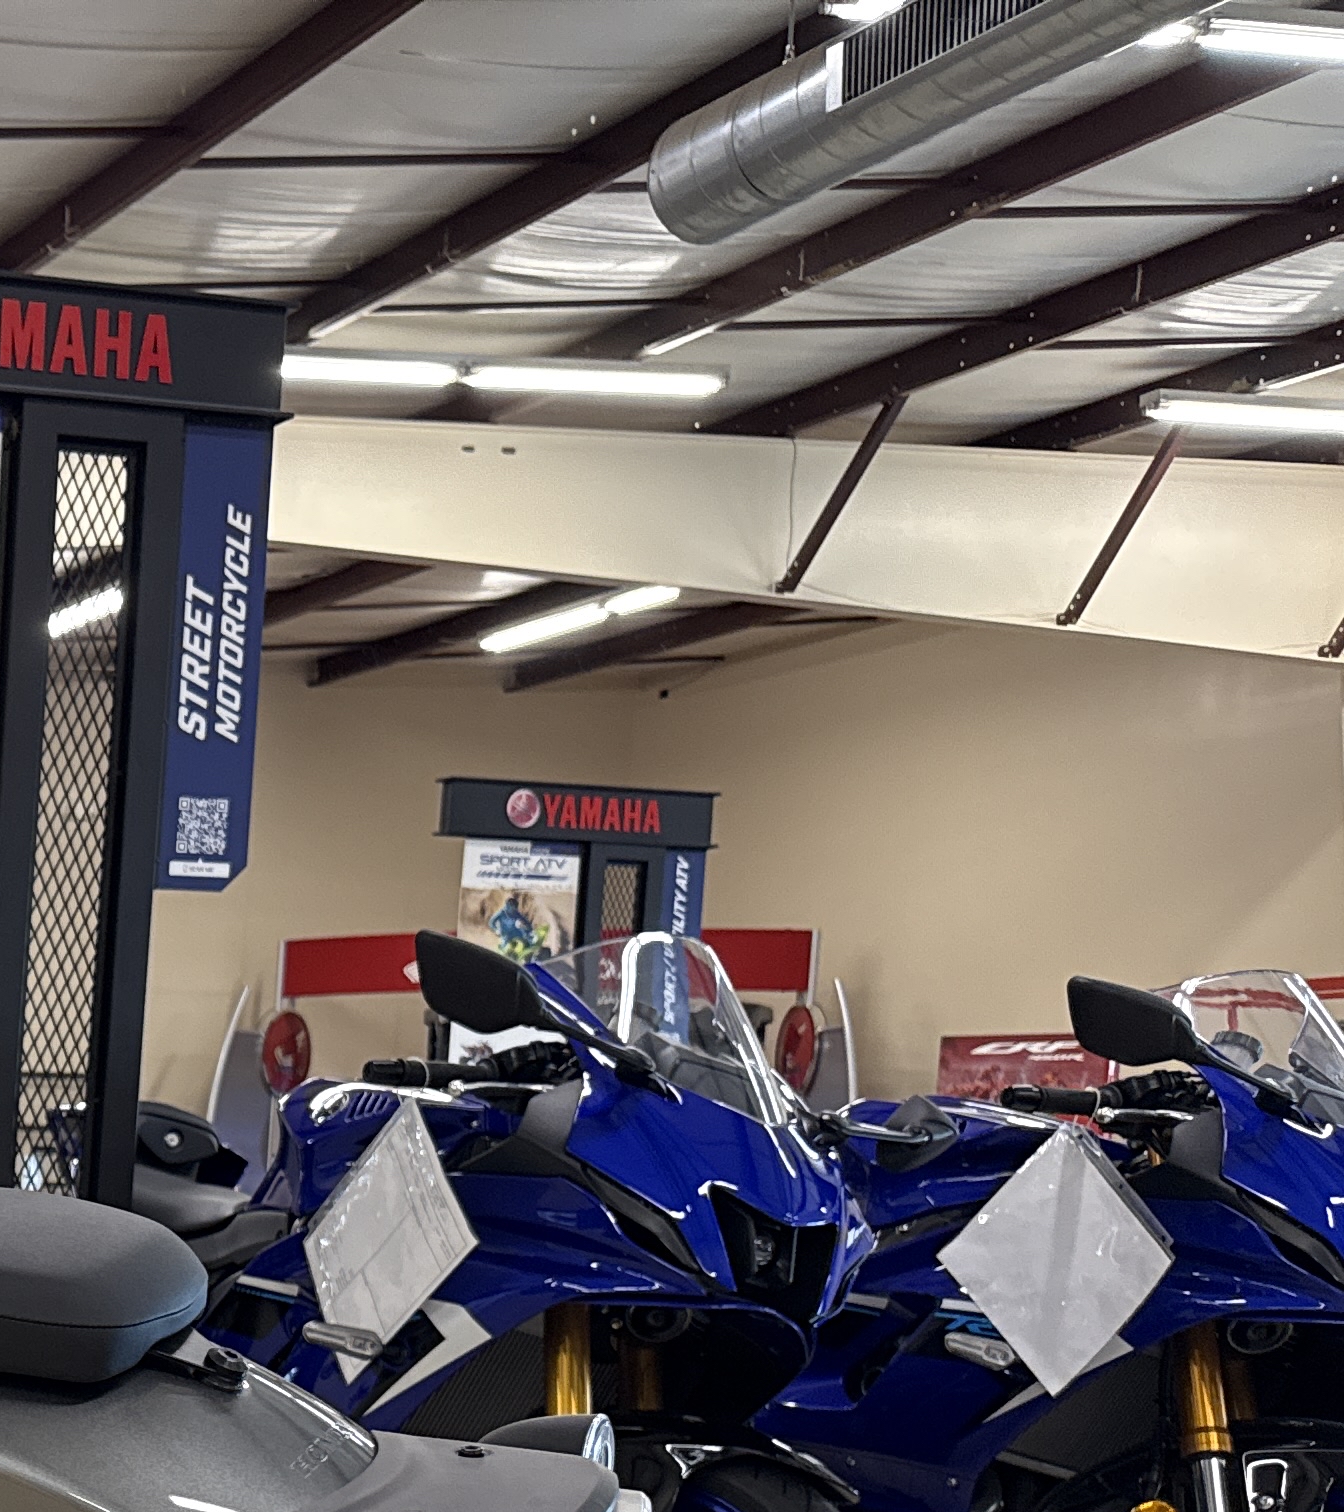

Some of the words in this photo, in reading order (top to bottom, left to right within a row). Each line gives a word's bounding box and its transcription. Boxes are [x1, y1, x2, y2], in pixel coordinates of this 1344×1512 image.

[178, 574, 217, 742] STREET
[213, 503, 254, 744] MOTORCYCLE
[479, 854, 531, 867] SPORT
[536, 858, 568, 871] ATV
[542, 793, 662, 834] YAMAHA
[663, 968, 678, 1026] SPORT
[676, 854, 691, 893] ATV
